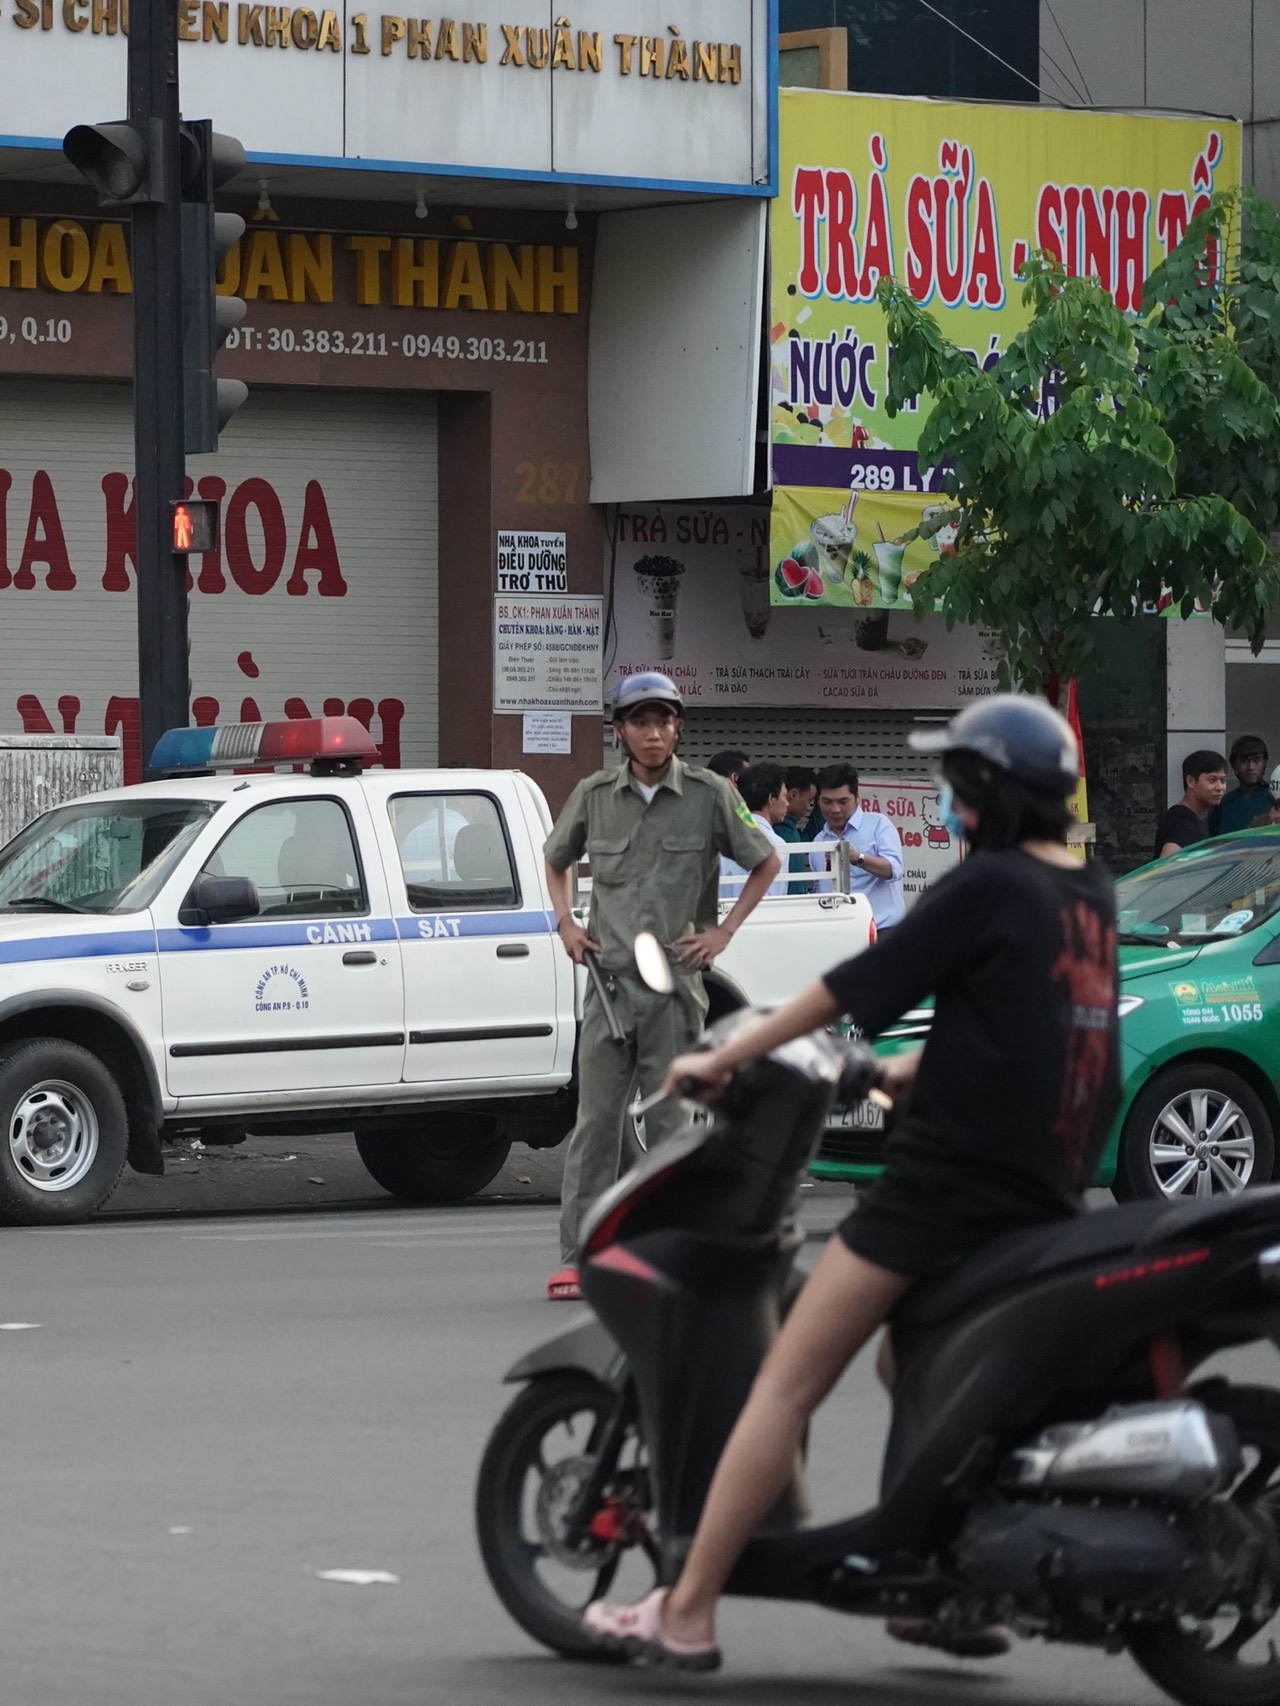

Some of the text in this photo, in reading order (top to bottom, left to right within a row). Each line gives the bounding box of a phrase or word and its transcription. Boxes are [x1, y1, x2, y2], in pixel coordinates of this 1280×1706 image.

[238, 3, 342, 53] KHOA
[350, 13, 372, 54] 1
[381, 14, 488, 63] PHAN
[500, 16, 603, 72] XUÂN
[614, 25, 743, 84] THÀNH
[793, 133, 895, 301] TRÀ
[904, 139, 1006, 309] SỮA
[1036, 182, 1150, 318] SINH
[348, 214, 579, 314] THÀNH
[21, 317, 71, 344] Q.10
[789, 325, 876, 411] NƯỚC
[850, 463, 896, 491] 289
[616, 506, 667, 543] TRÀ
[499, 535, 516, 548] NHA
[517, 535, 540, 548] KHOA
[530, 606, 551, 620] PHAN
[552, 605, 573, 620] XUÂN
[574, 604, 600, 620] THÀNH
[861, 794, 917, 818] RÀ SỮA
[1220, 1003, 1264, 1022] 1055
